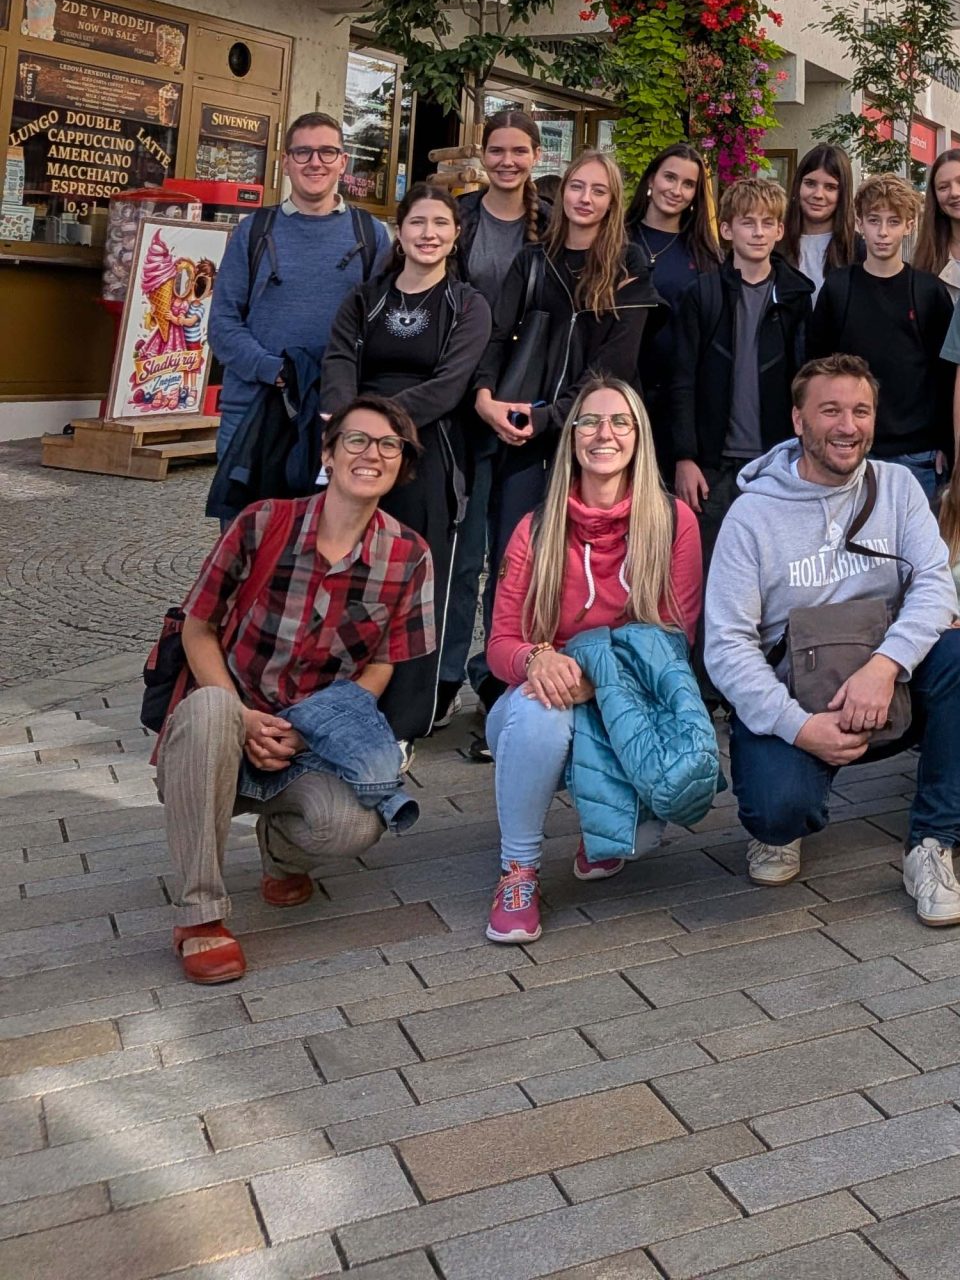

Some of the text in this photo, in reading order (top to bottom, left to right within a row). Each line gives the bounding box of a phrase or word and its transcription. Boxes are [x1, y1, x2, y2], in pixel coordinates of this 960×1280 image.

[61, 0, 155, 34] ZDE V PRODEJI
[78, 21, 138, 42] NOW ON SALE
[9, 110, 60, 147] LUNGO
[67, 111, 122, 132] DOUBLE
[211, 112, 260, 133] SUVENÝRY
[48, 128, 136, 152] CAPPUCCINO
[136, 128, 172, 169] LATTE
[47, 145, 132, 168] AMERICANO
[46, 162, 129, 185] MACCHIATO
[139, 350, 197, 381] Sladký ráj
[152, 375, 182, 393] Znojmo
[789, 538, 891, 587] HOLLABRUNN
